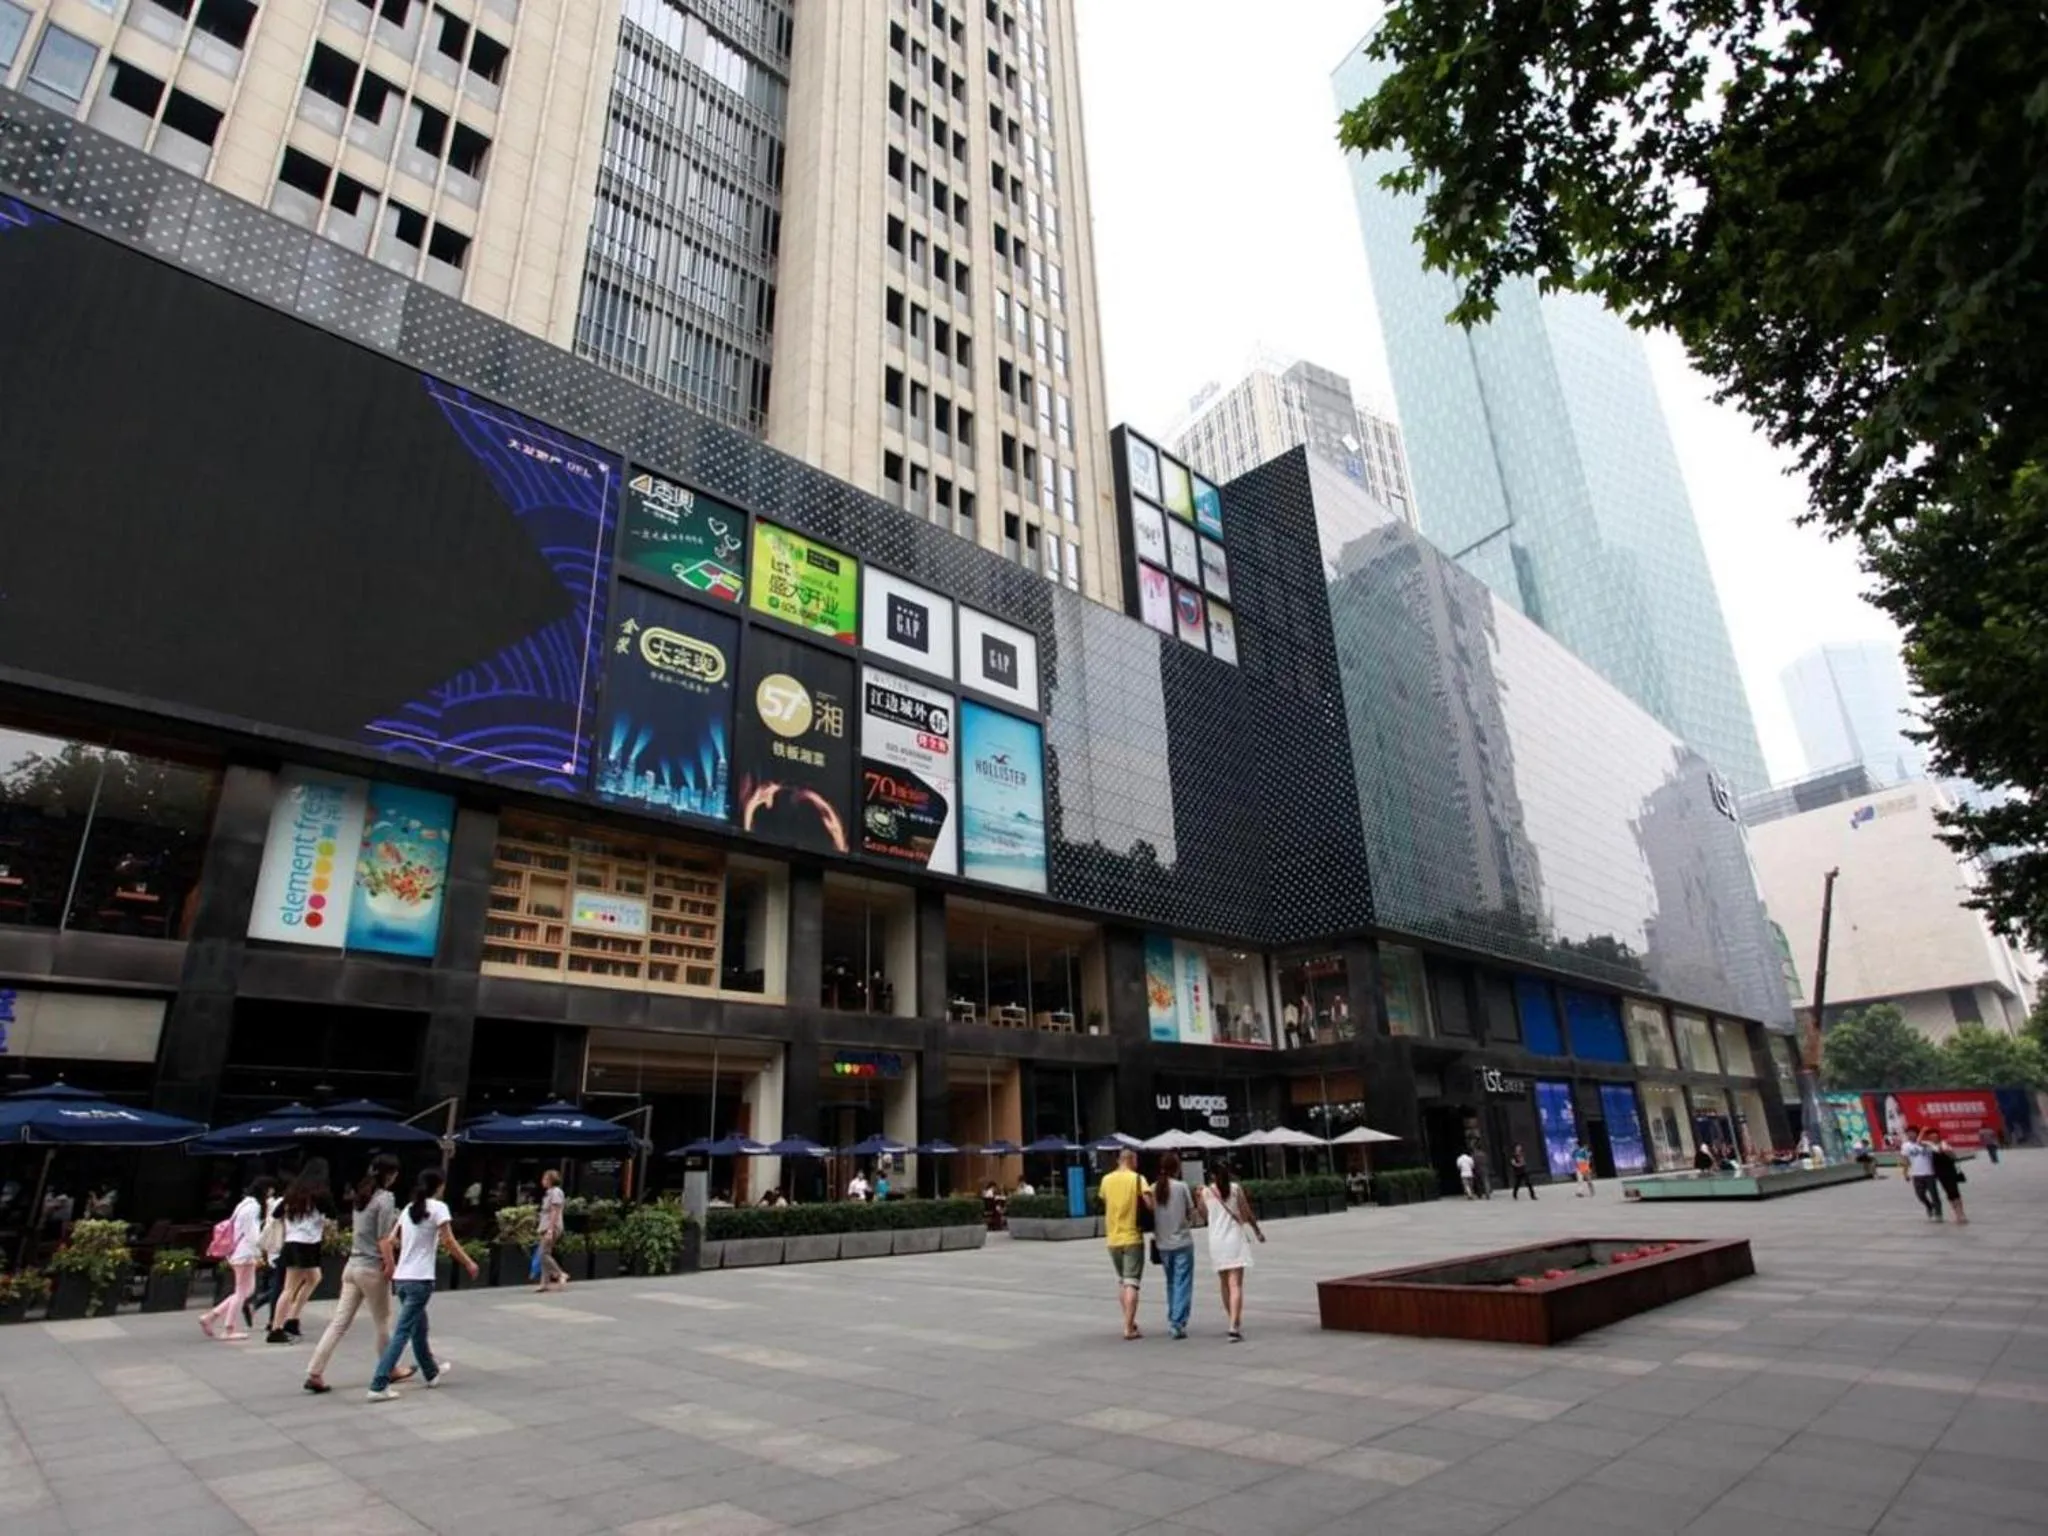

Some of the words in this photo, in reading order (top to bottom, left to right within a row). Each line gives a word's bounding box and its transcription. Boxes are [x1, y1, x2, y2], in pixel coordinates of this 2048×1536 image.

[769, 574, 839, 616] 盛大开业
[896, 612, 921, 639] GAP
[989, 649, 1010, 674] GAP
[815, 702, 844, 738] 湘
[870, 687, 928, 722] 江边城外
[975, 758, 1027, 788] HOLLISTER
[279, 836, 317, 926] element
